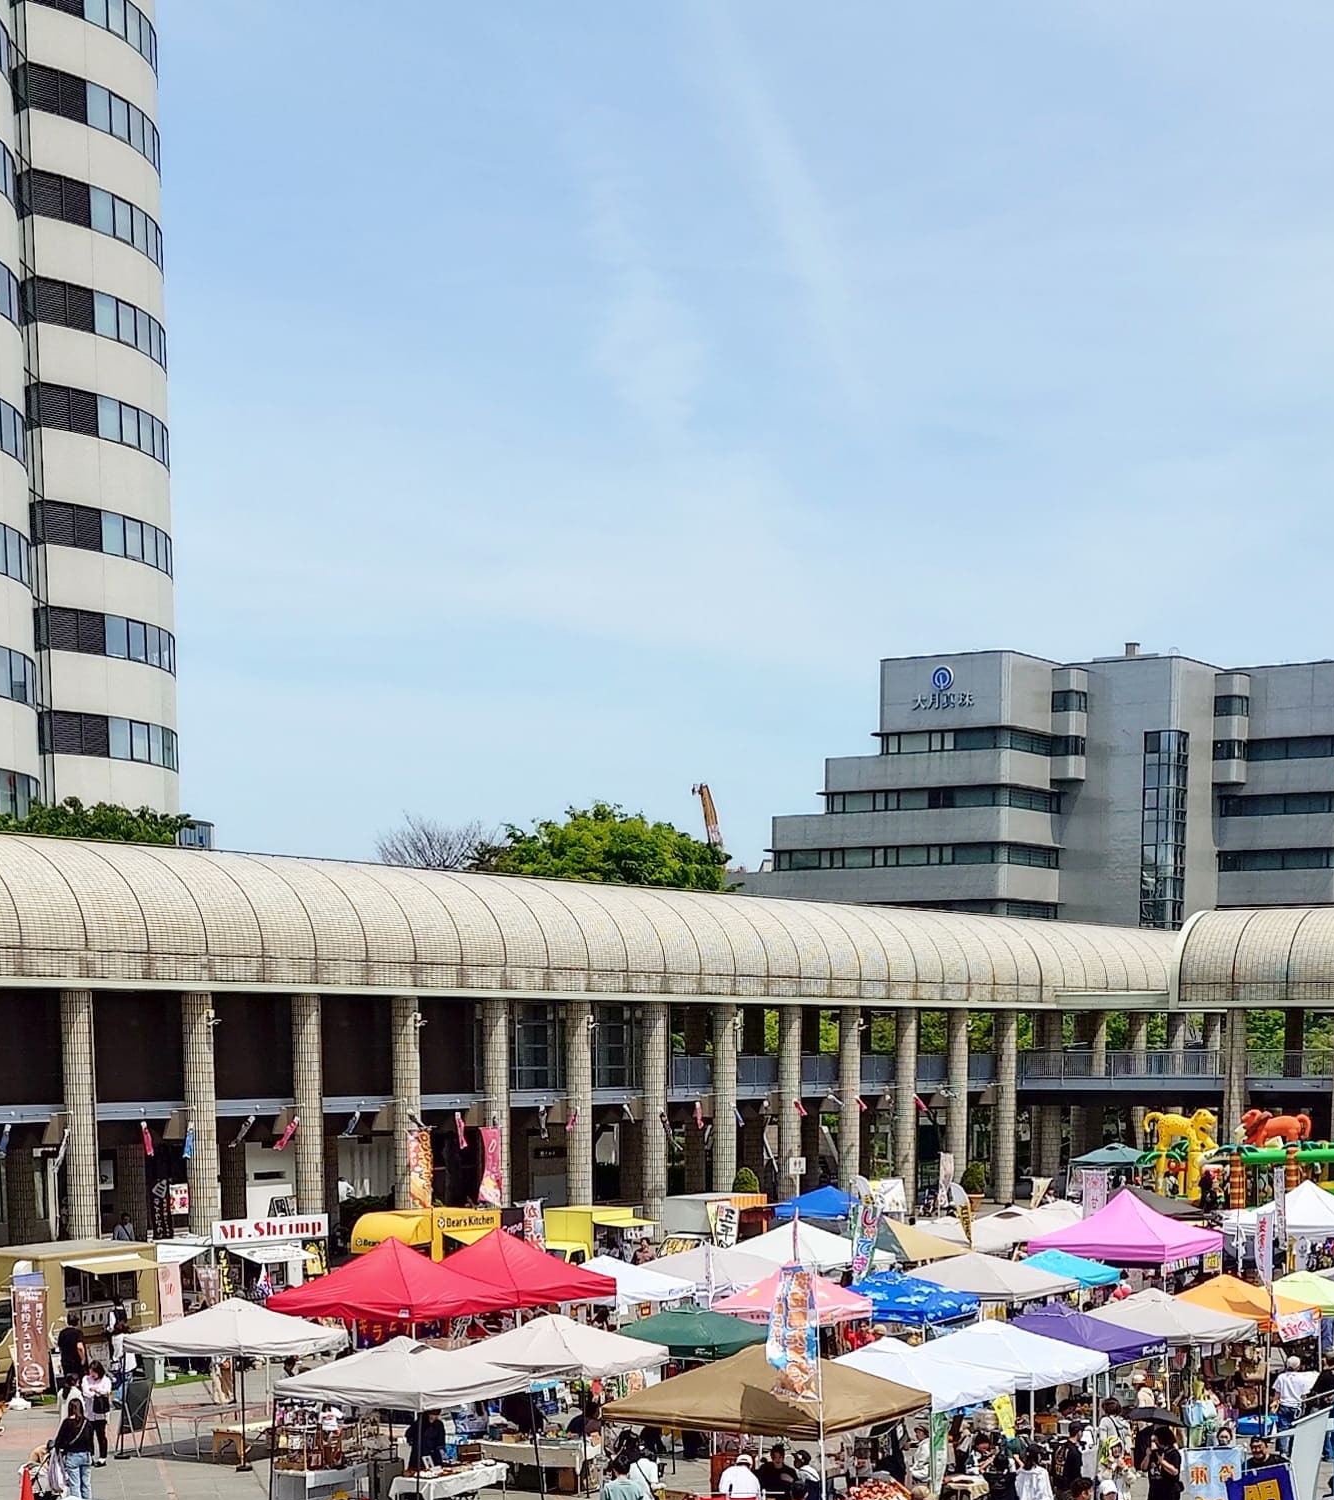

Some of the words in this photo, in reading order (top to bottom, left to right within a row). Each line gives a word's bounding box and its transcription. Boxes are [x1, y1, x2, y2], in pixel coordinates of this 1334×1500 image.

[446, 1217, 468, 1228] Dear's
[469, 1215, 495, 1227] Kitchen
[219, 1220, 323, 1240] Mr.Shrimp
